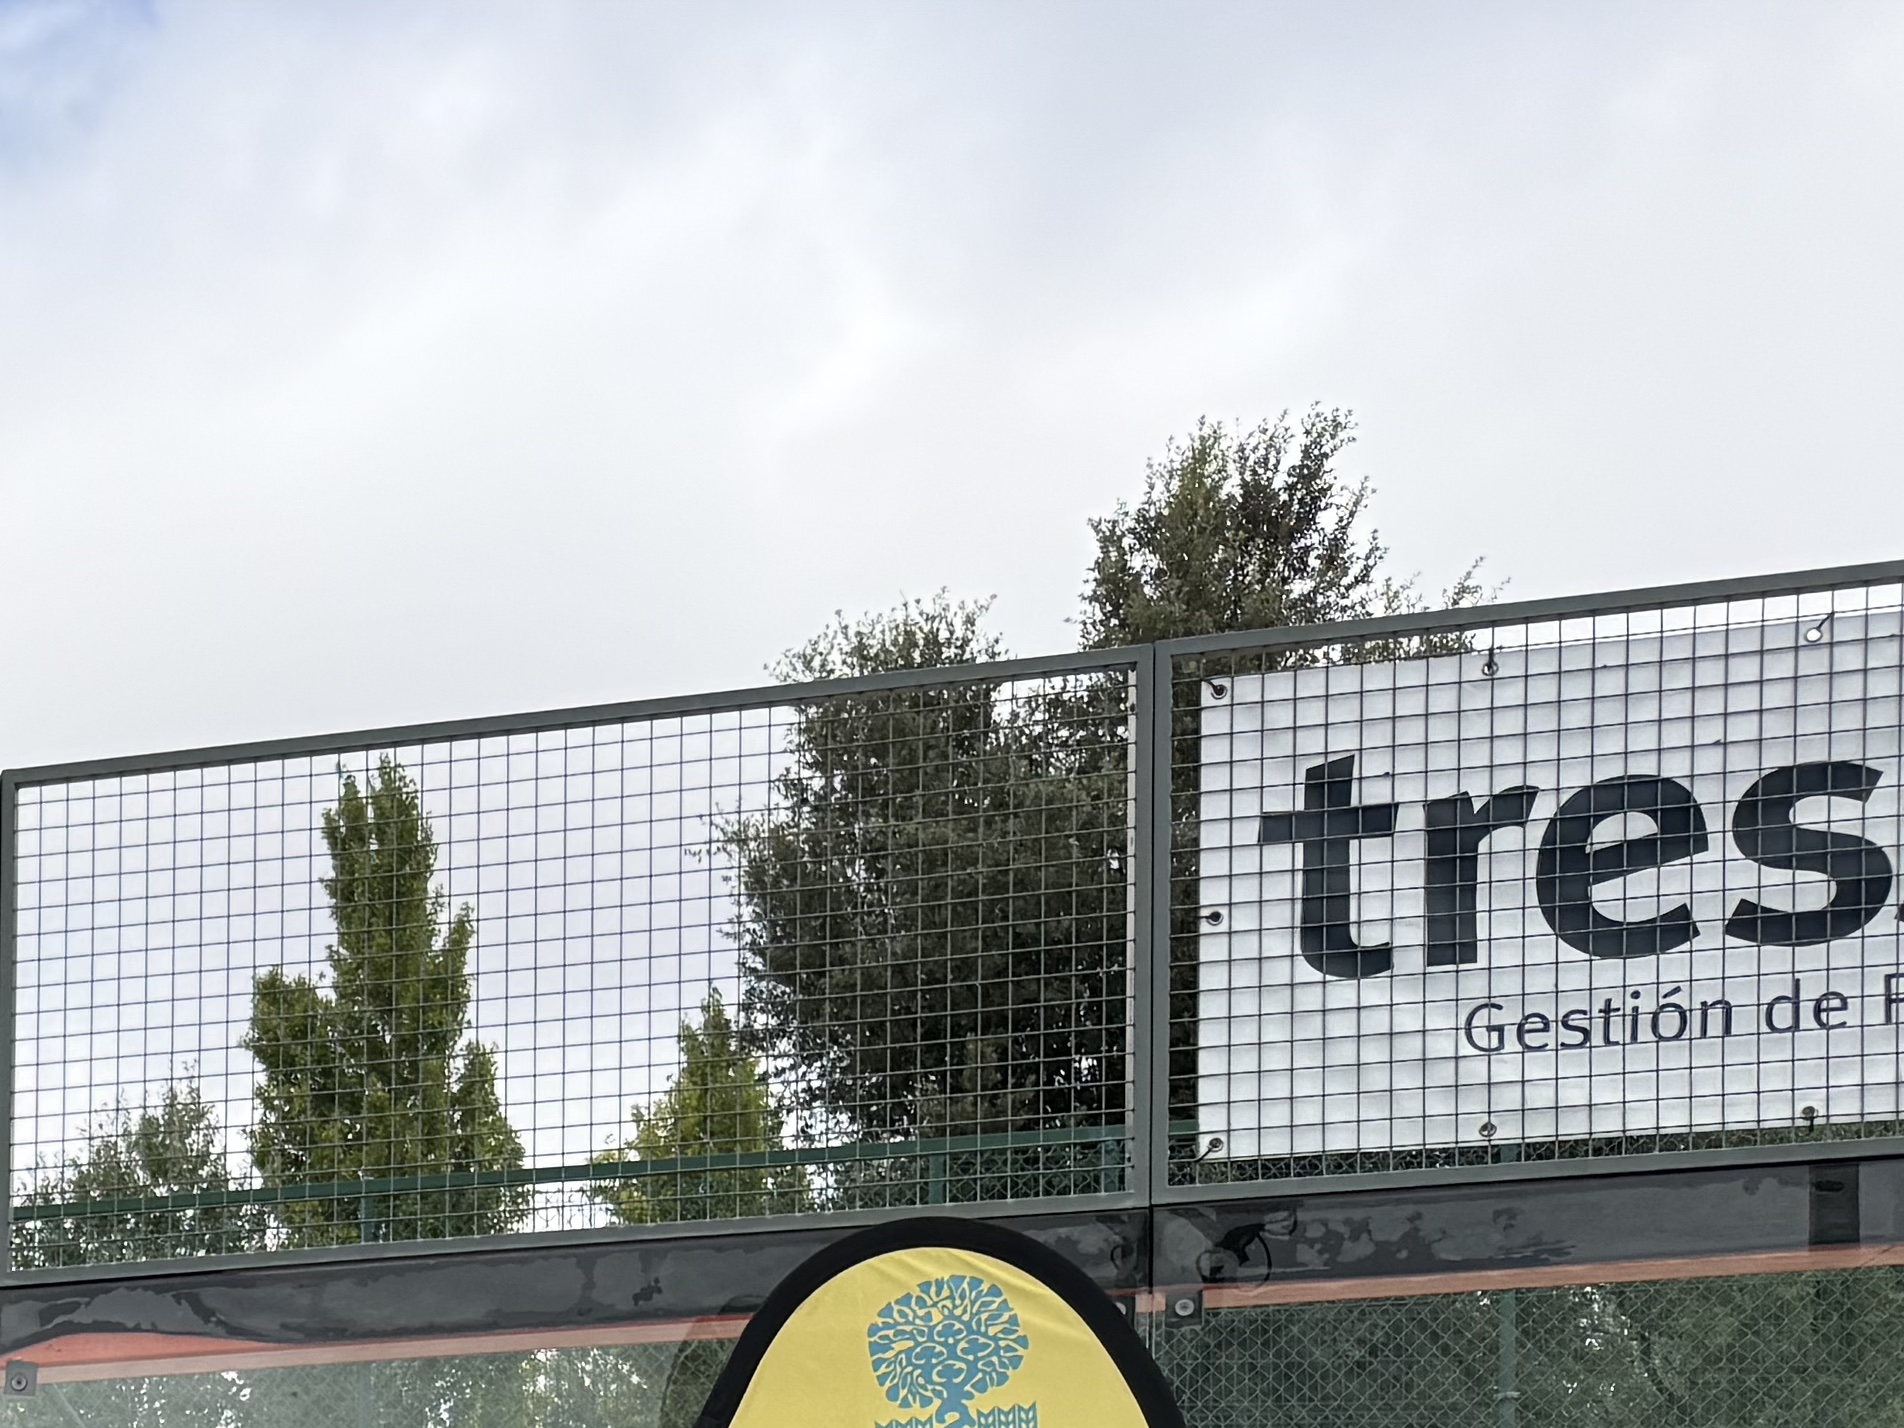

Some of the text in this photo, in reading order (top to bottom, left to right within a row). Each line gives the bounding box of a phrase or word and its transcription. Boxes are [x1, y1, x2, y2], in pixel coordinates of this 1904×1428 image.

[1258, 754, 1904, 979] tres
[1465, 986, 1733, 1053] Gestión
[1766, 979, 1849, 1033] de
